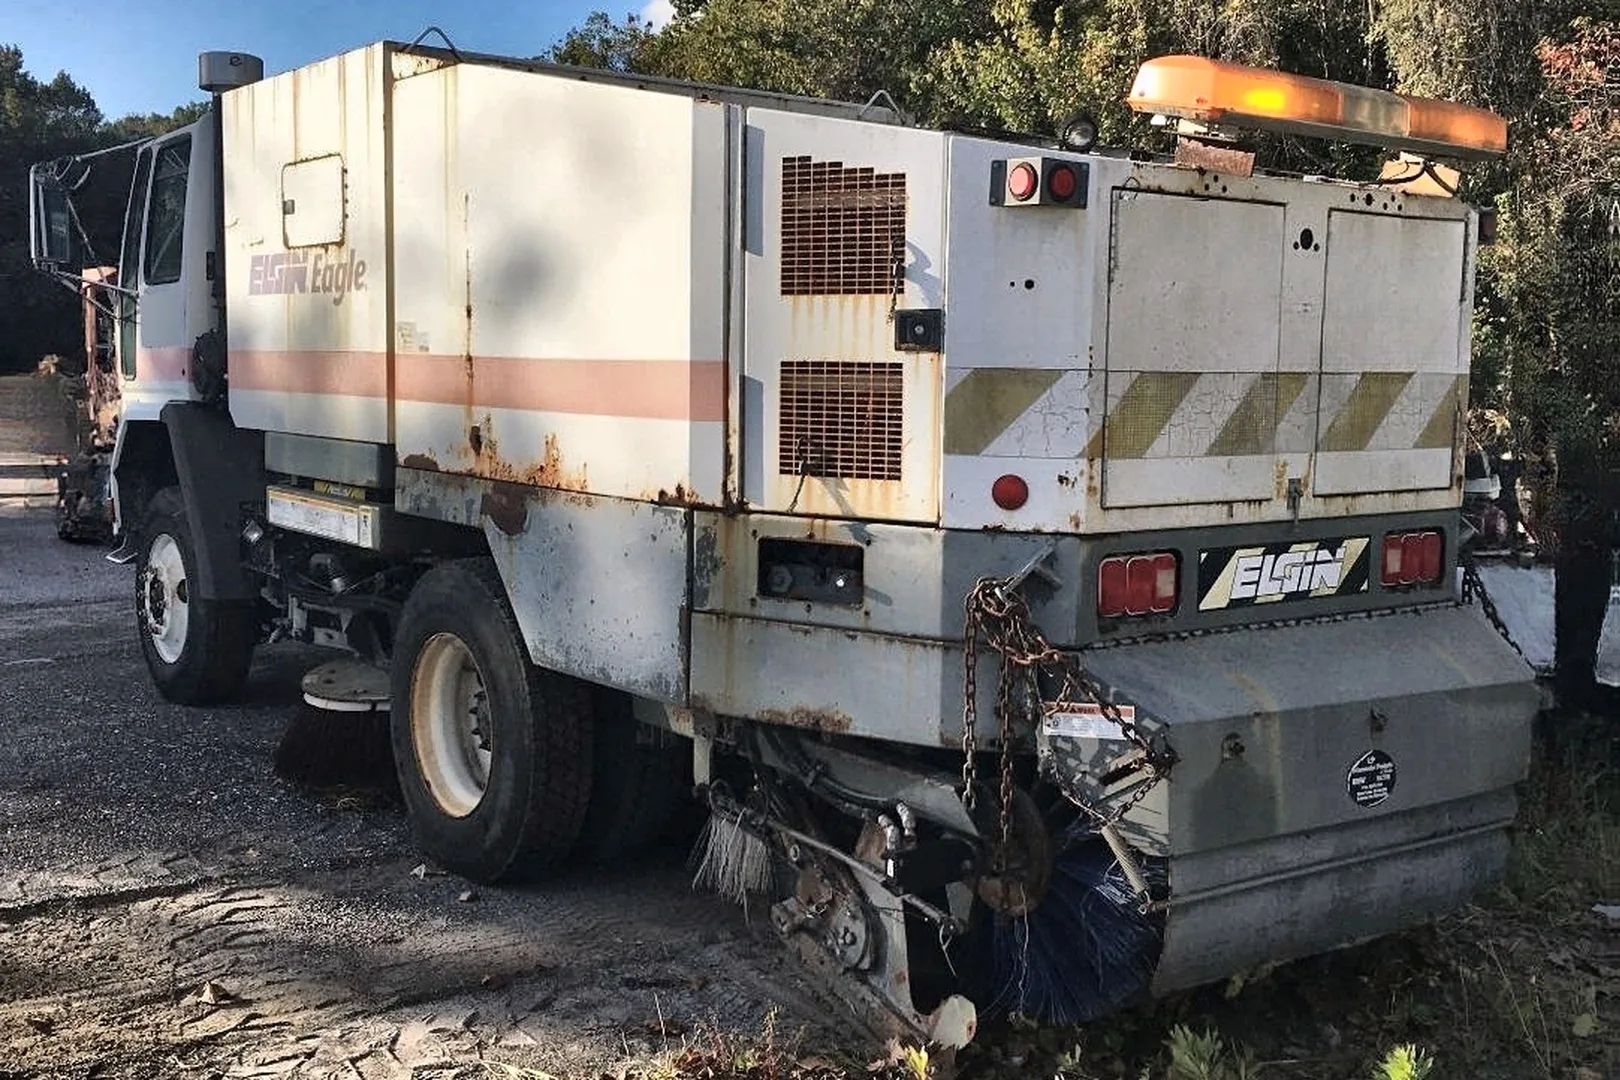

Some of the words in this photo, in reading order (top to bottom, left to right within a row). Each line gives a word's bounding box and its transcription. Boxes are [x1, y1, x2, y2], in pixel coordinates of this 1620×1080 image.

[250, 252, 308, 295] ELGIN
[311, 249, 366, 306] Eagle
[1230, 547, 1346, 600] ELGIN
